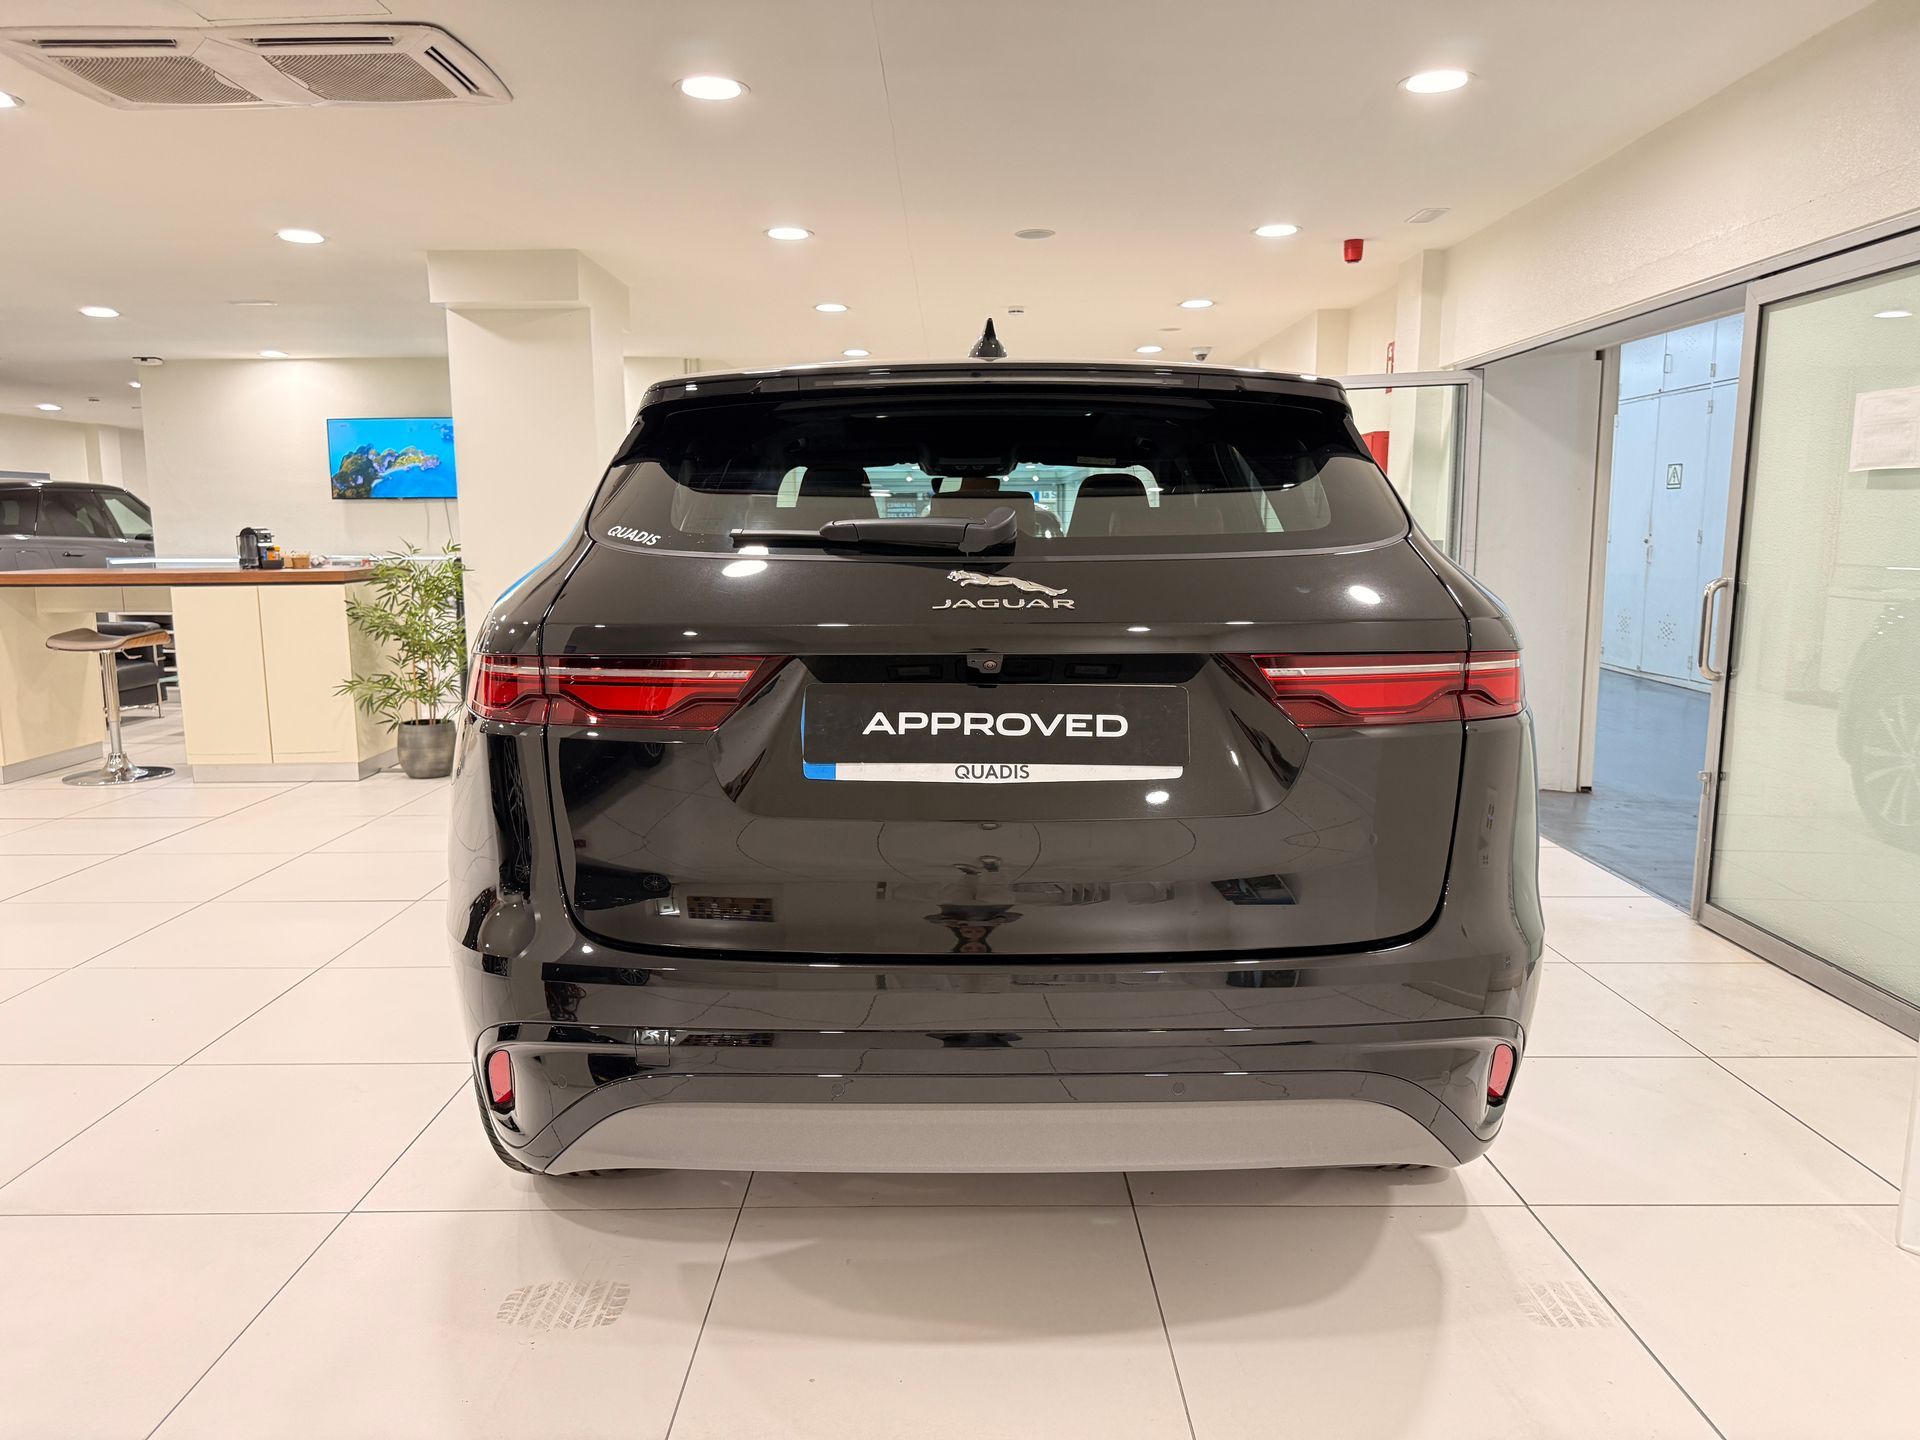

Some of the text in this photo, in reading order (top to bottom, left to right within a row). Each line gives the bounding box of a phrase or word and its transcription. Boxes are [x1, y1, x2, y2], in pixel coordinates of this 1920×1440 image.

[607, 525, 662, 546] QUADIS
[931, 598, 1076, 610] JAGUAR
[862, 711, 1129, 738] APPROVED
[954, 764, 1030, 780] QUADIS
